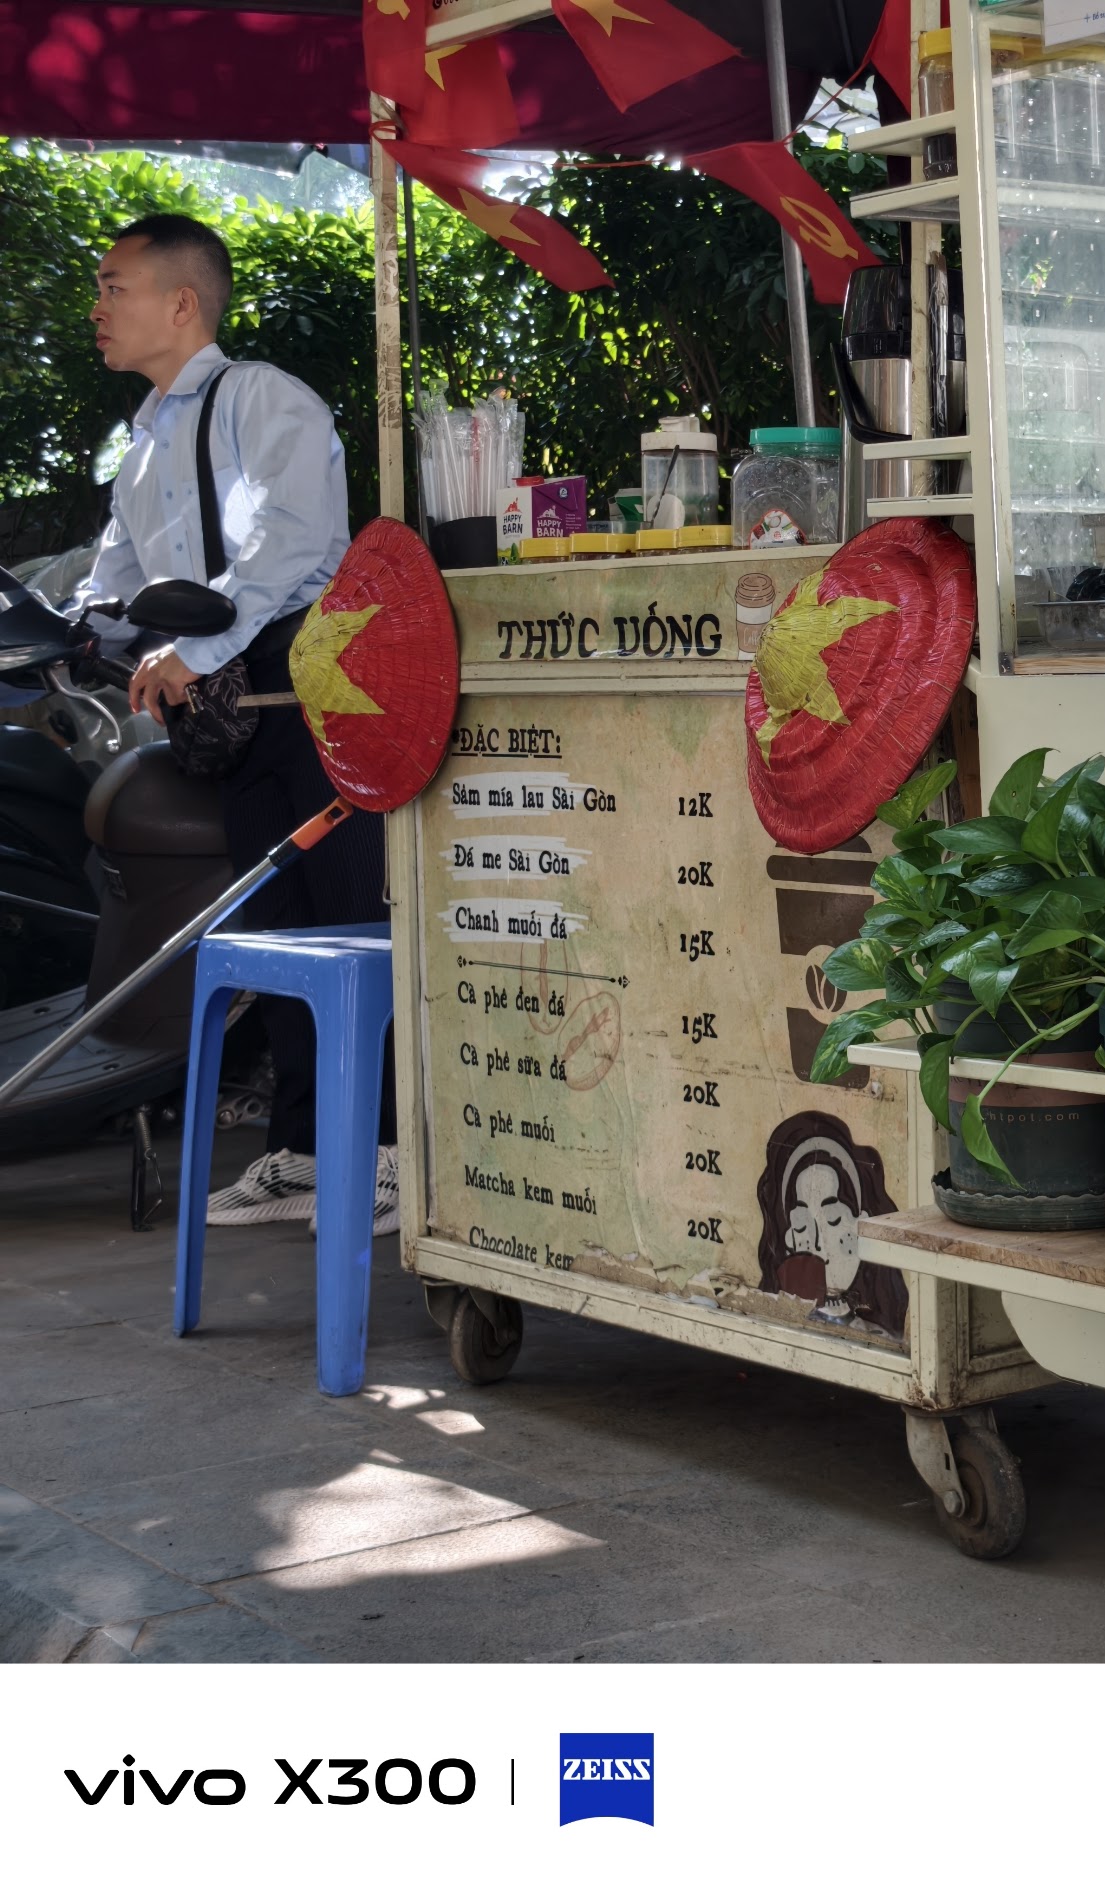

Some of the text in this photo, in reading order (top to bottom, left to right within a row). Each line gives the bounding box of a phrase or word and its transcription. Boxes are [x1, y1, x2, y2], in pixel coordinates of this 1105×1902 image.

[502, 523, 523, 535] BARN
[503, 514, 522, 524] HAPPY
[536, 527, 564, 538] BARN
[537, 519, 562, 528] HAPPY
[498, 601, 722, 659] THỨC UỐNG
[508, 723, 561, 756] BIỆT:
[453, 782, 713, 817] Sâm mía lau Sài Gòn 12K
[454, 843, 714, 887] Đá me Sài Gòn 20K
[455, 906, 715, 962] Chanh muối đá 15K
[458, 980, 718, 1044] Cà phê đen đá 15K
[460, 1042, 720, 1107] Cà phê sữa đá 20K
[463, 1103, 723, 1176] Cà phê muối 20K
[464, 1164, 724, 1244] Matcha kem muối 20K
[469, 1226, 575, 1272] Chocolate kem
